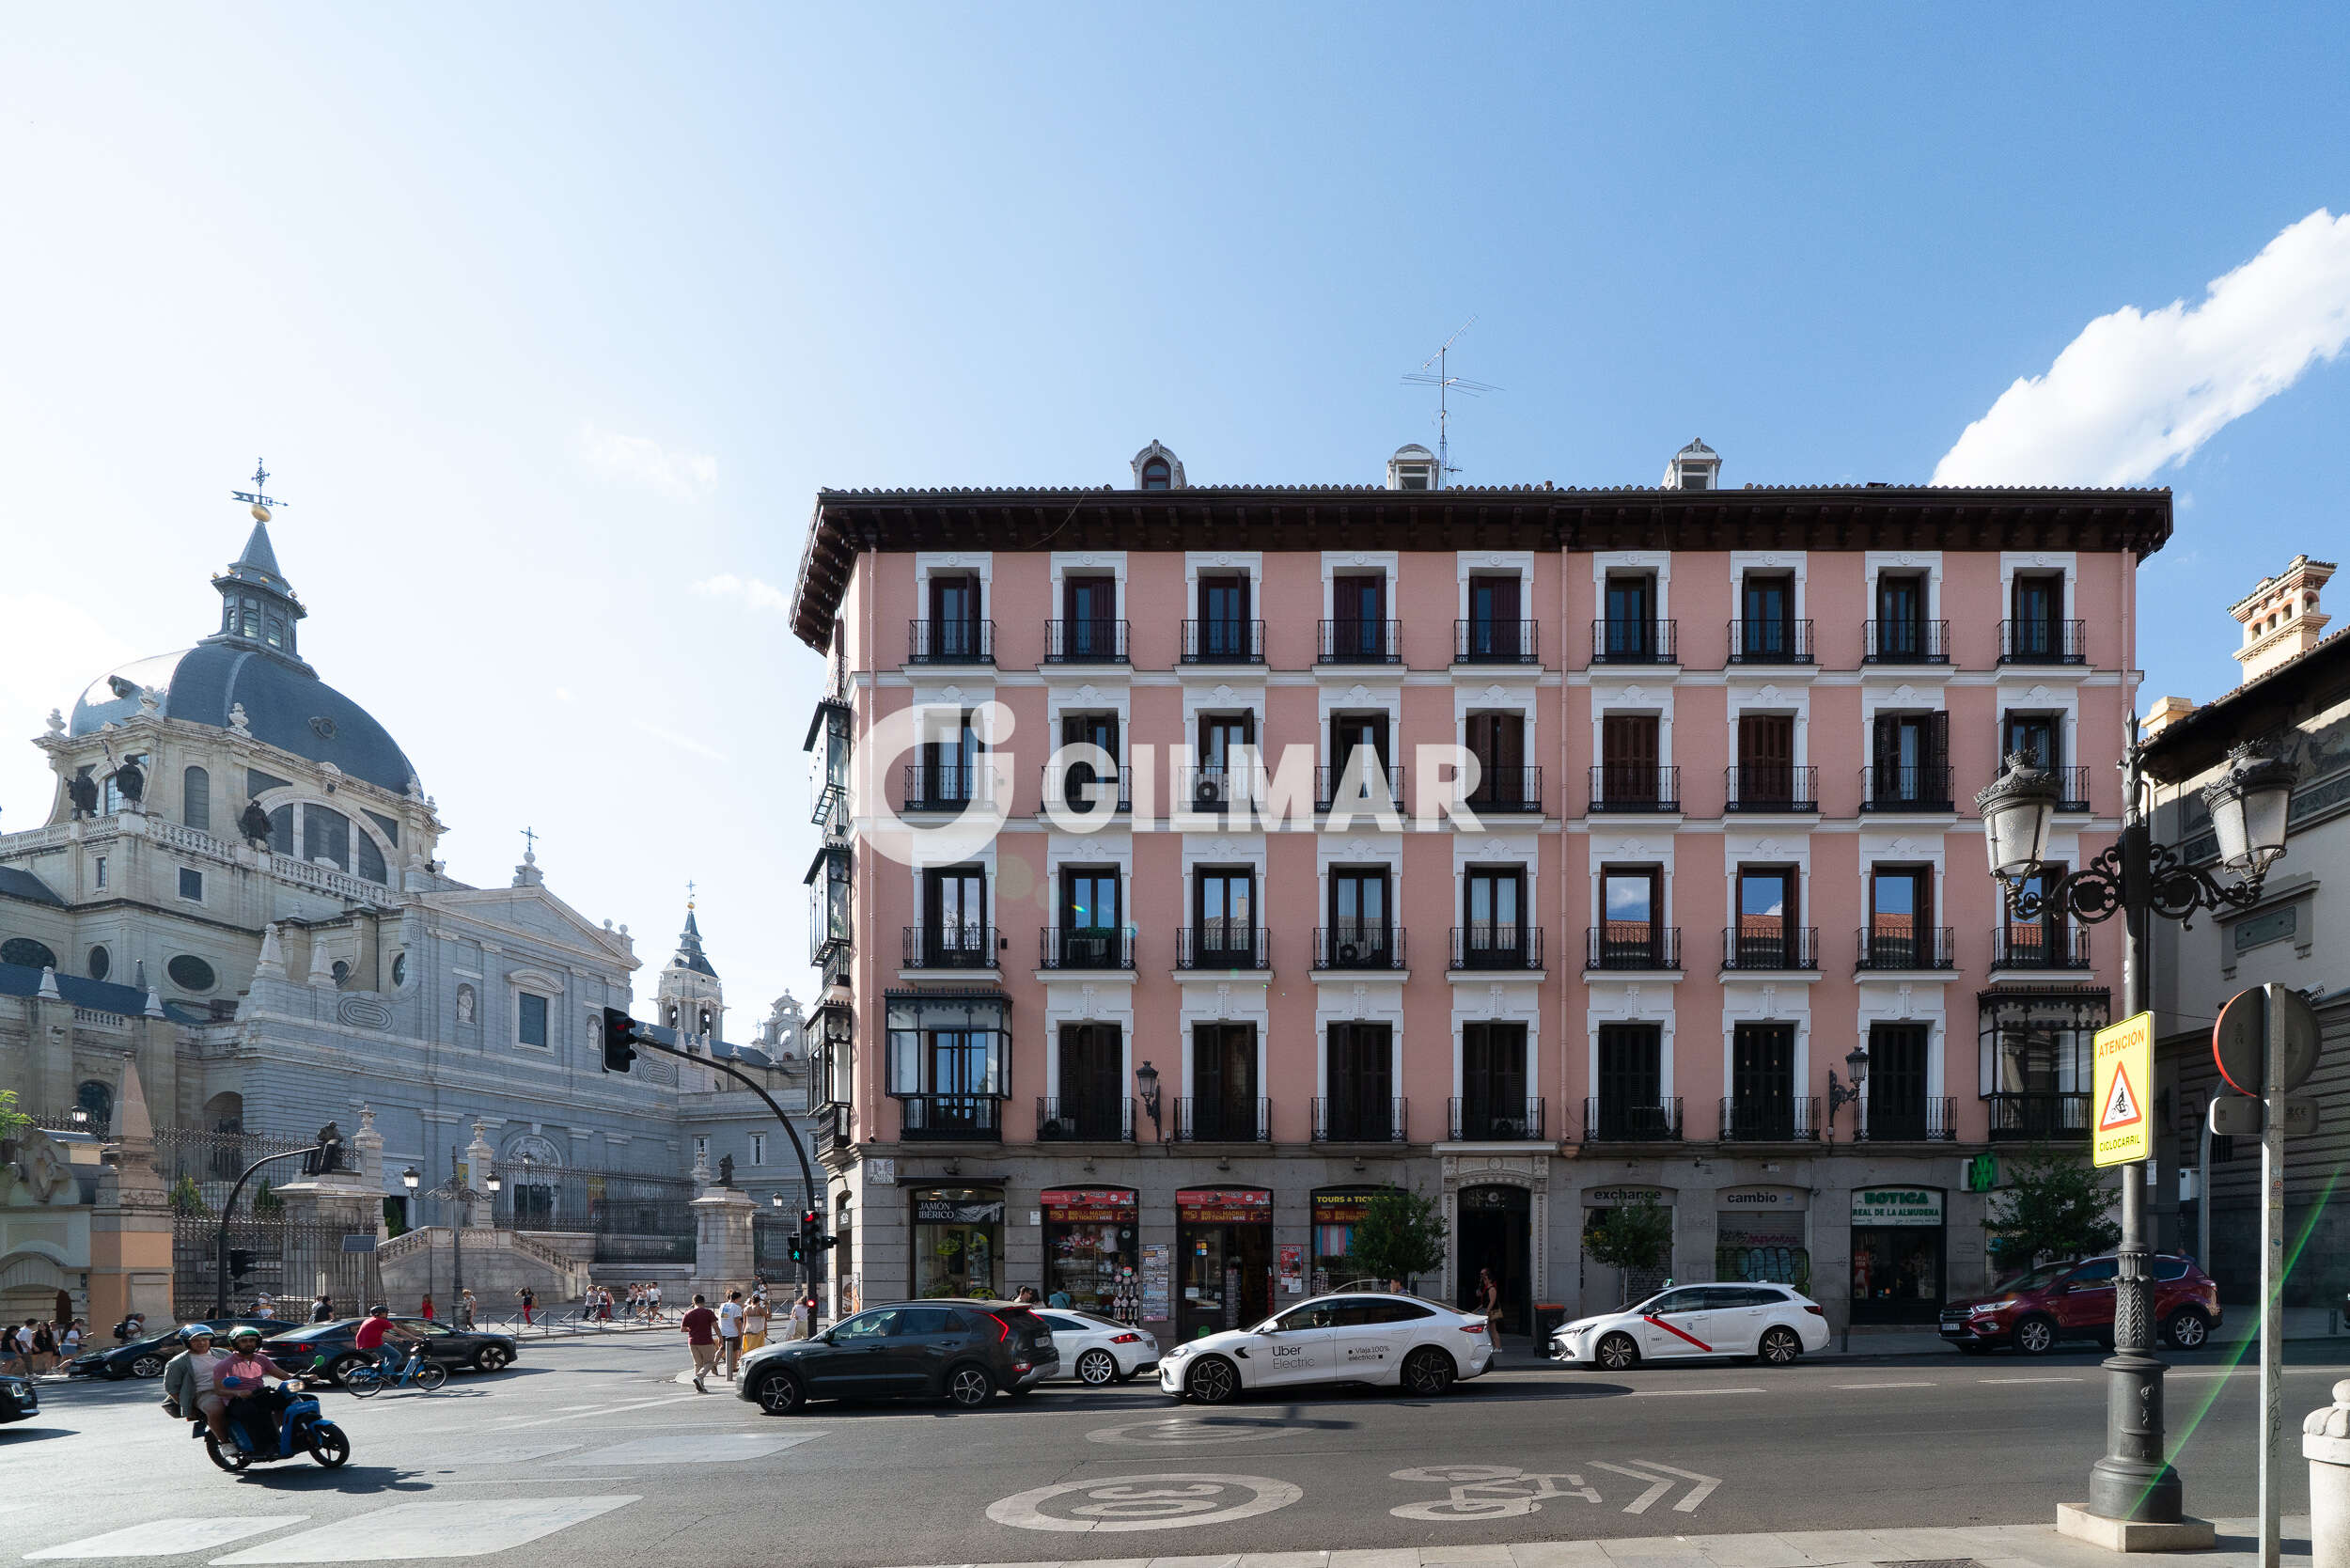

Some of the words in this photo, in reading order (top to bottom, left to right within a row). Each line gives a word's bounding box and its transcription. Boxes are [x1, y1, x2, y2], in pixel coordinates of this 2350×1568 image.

[2098, 1028, 2144, 1059] ATENCIÓN
[2099, 1135, 2140, 1152] CICLOCARRIL
[1728, 1192, 1778, 1203] cambio
[1864, 1192, 1928, 1204] BOTICA
[918, 1201, 950, 1210] JAMÓN
[1272, 1345, 1301, 1356] Uber
[1273, 1357, 1316, 1370] Electric
